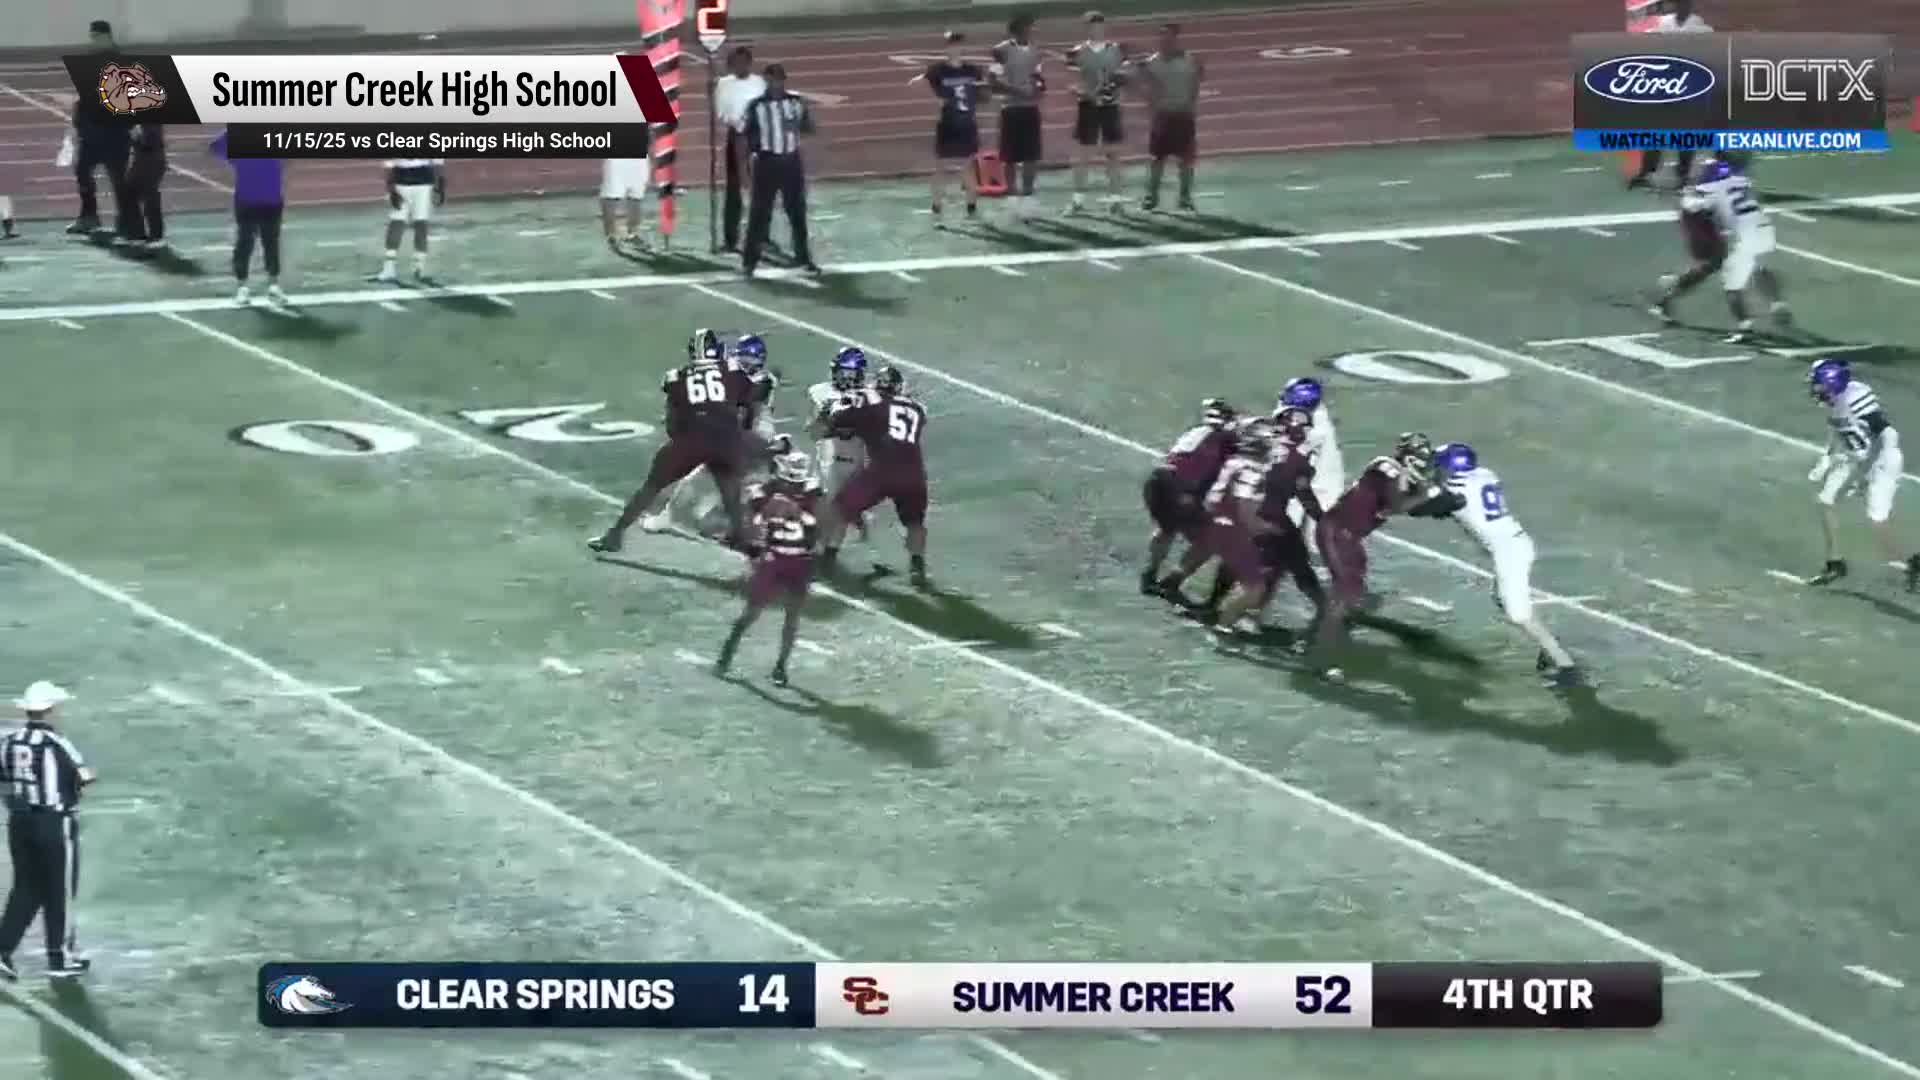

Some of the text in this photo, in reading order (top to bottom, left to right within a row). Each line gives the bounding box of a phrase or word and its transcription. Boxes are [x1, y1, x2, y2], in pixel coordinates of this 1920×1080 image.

[686, 370, 726, 404] 66
[888, 403, 920, 444] 57
[13, 744, 37, 781] R
